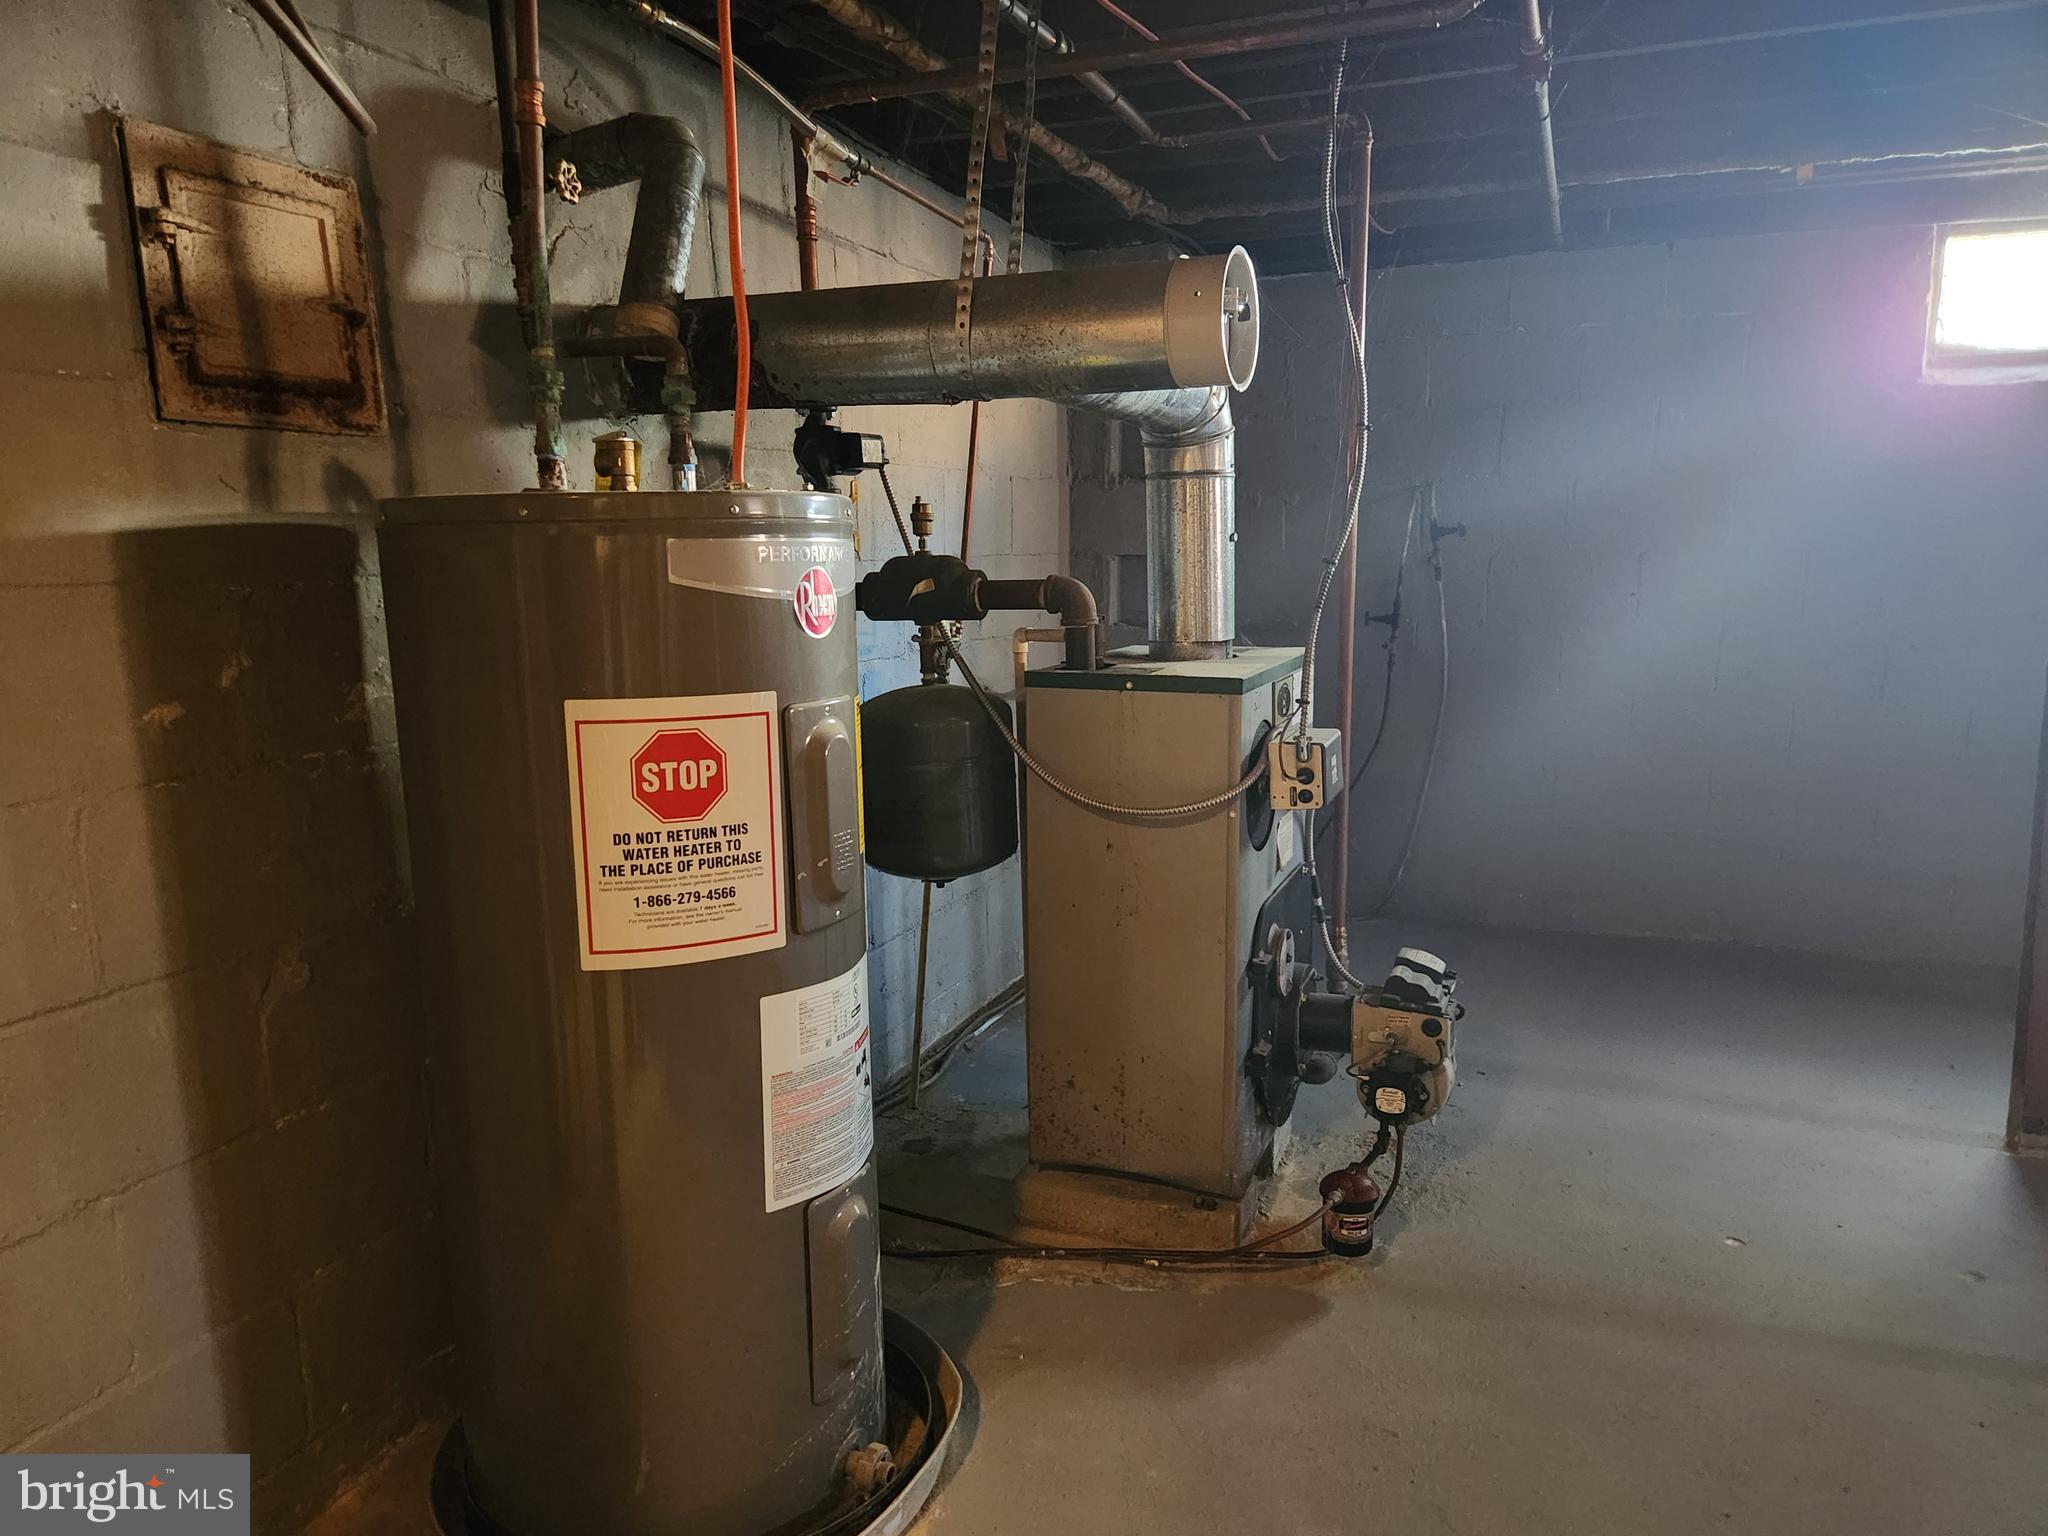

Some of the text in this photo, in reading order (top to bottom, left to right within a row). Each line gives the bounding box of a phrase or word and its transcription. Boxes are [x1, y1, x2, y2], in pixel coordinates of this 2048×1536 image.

[799, 569, 836, 627] Rheem
[641, 759, 717, 793] STOP
[613, 822, 749, 847] DO NOT RETURN THIS
[622, 838, 742, 861] WATER HEATER TO
[599, 850, 763, 878] THE PLACE OF PURCHASE
[633, 886, 736, 909] 1-866-279-4566
